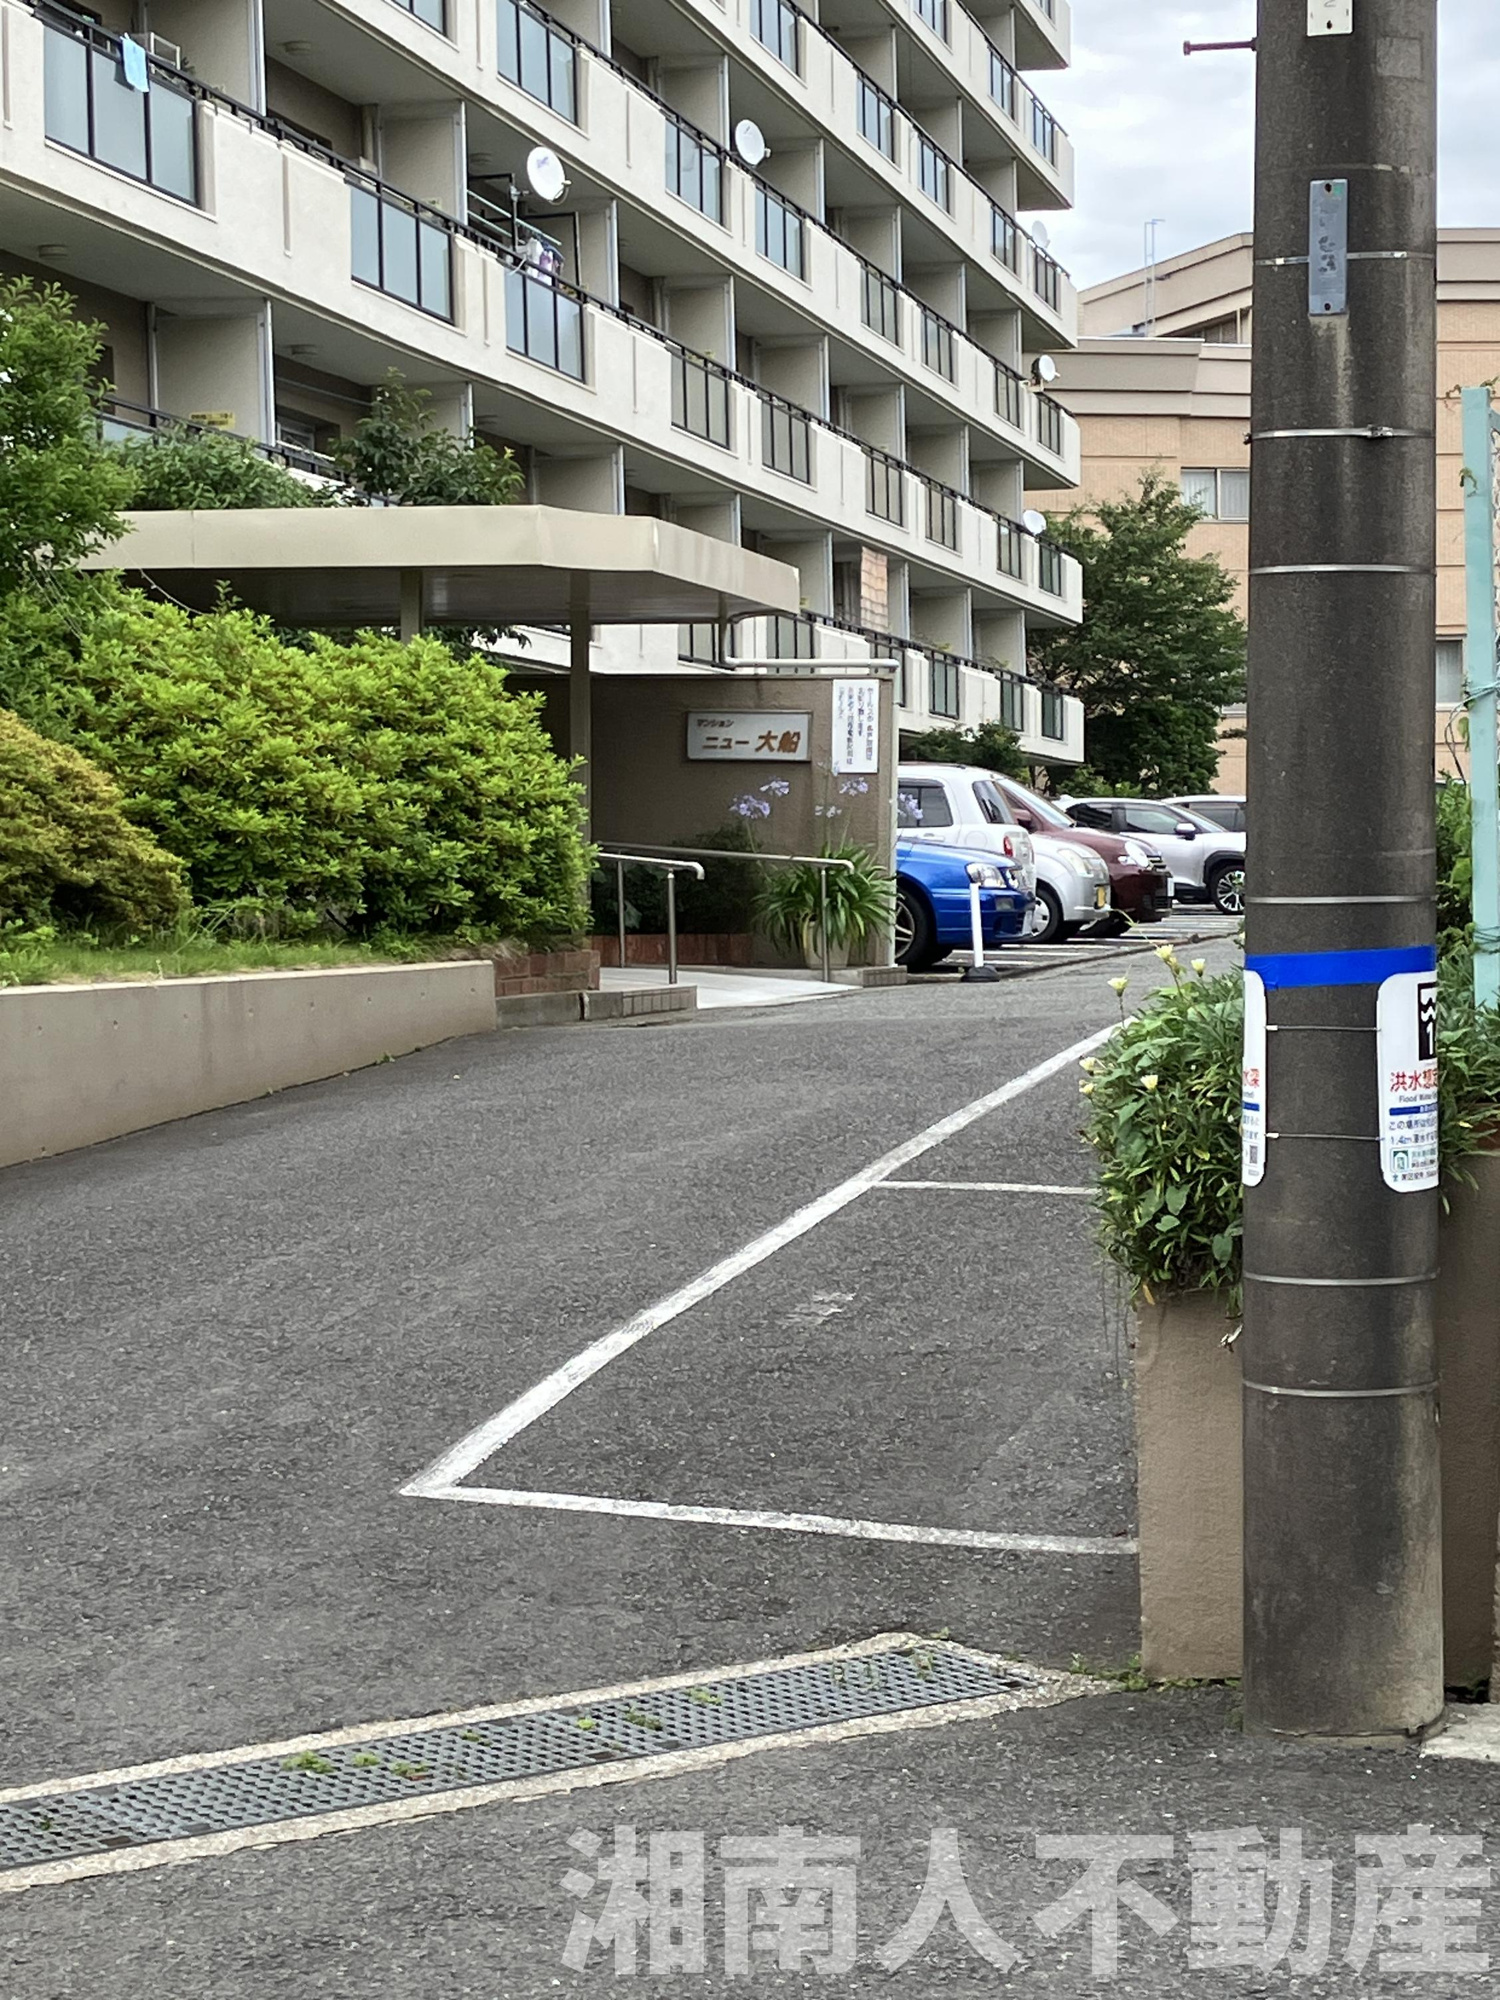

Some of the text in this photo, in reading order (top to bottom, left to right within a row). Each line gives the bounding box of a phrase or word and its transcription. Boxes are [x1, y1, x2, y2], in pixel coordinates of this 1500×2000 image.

[696, 718, 734, 728] マンション
[702, 730, 801, 753] ニュー 大船
[1398, 1094, 1417, 1103] Flood
